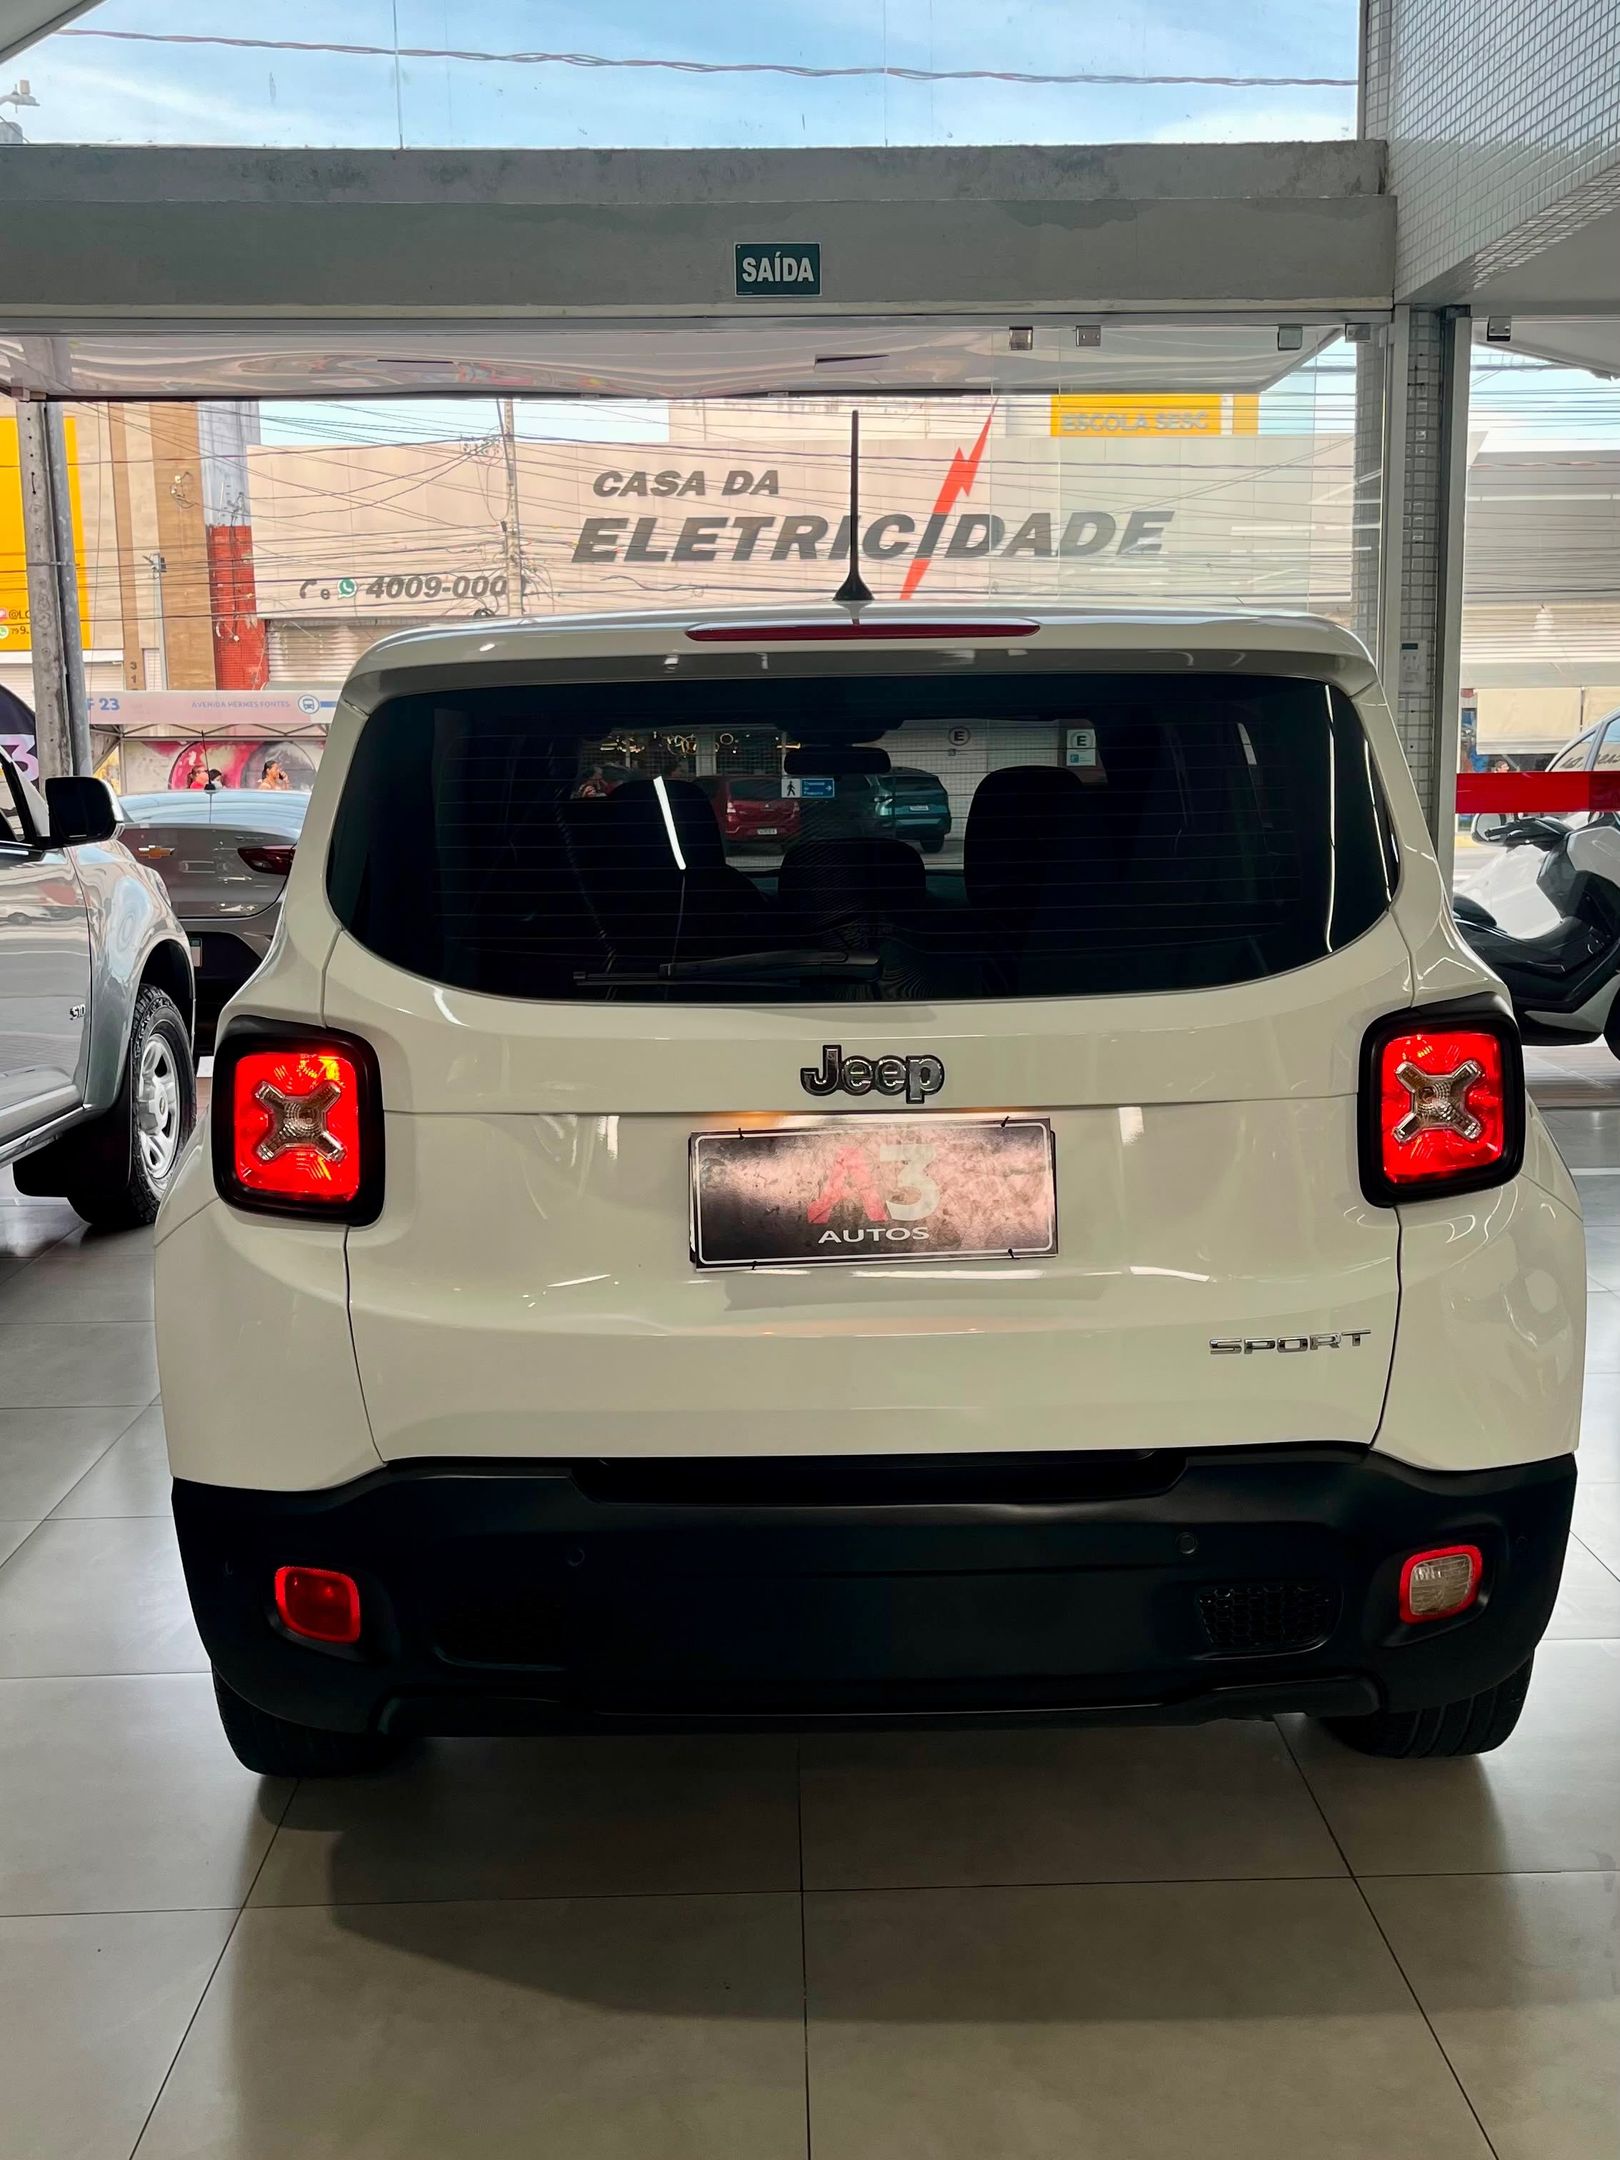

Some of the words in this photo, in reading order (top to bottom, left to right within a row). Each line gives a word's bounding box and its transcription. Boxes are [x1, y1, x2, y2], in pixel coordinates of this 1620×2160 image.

[742, 252, 815, 282] SAÍDA
[1062, 412, 1149, 431] ESCOLA
[1155, 411, 1208, 430] SESC
[593, 470, 706, 497] CASA
[722, 470, 780, 496] DA
[571, 510, 1175, 562] ELETRICIDADE
[366, 576, 526, 599] 4009-000
[100, 698, 120, 711] 23
[192, 701, 227, 709] AVENIDA
[1076, 735, 1087, 746] E
[800, 1045, 945, 1104] Jeep
[807, 1144, 940, 1223] A3
[818, 1227, 930, 1244] AUTOS
[1209, 1329, 1372, 1355] SPORT
